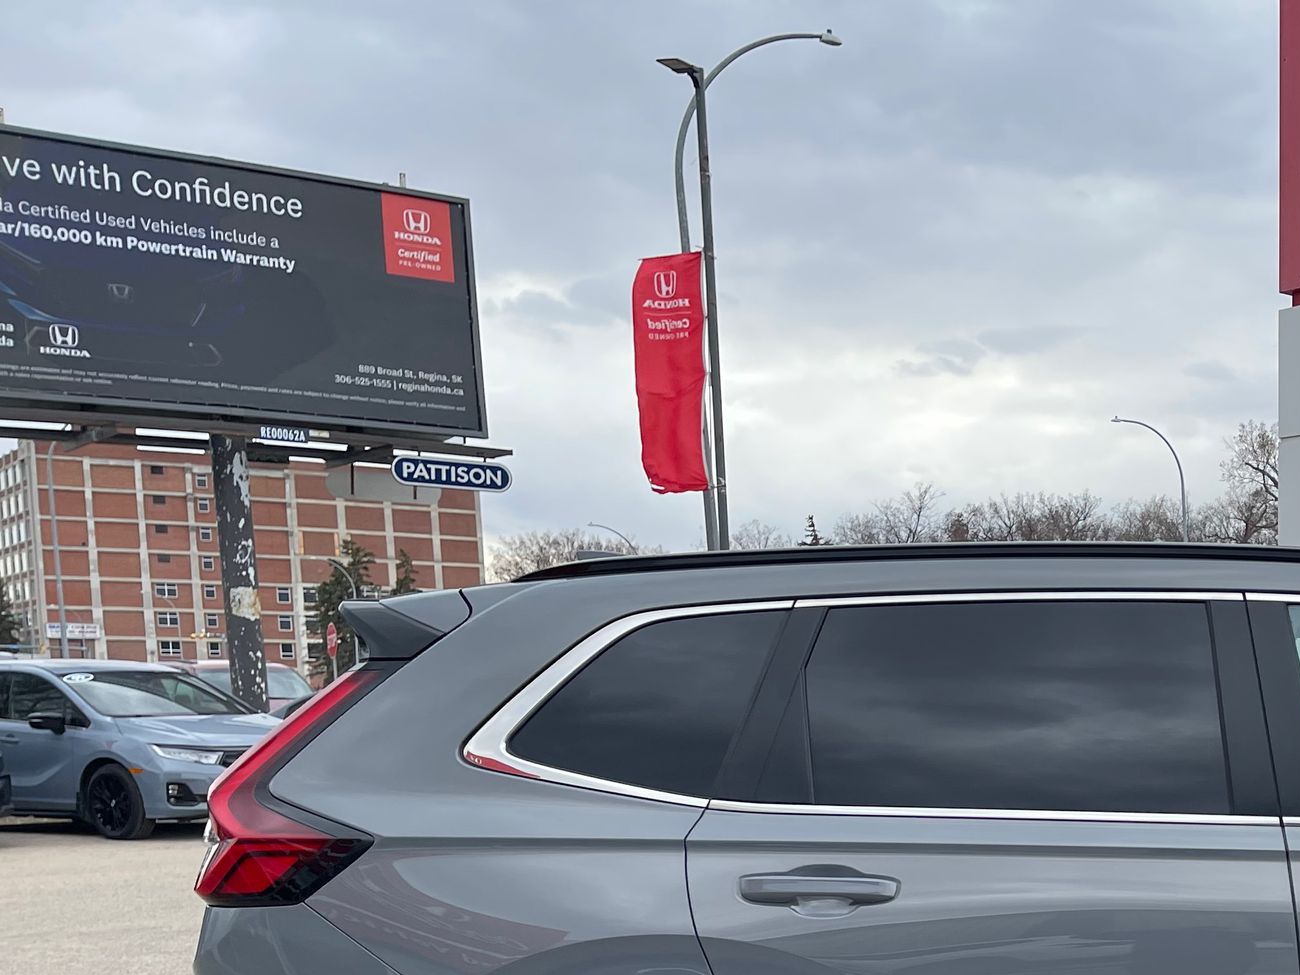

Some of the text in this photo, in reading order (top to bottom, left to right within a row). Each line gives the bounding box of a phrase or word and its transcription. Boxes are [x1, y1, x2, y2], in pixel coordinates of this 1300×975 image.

[51, 160, 121, 192] with
[131, 170, 303, 218] Confidence
[18, 200, 91, 224] Certified
[95, 210, 136, 230] Used
[140, 216, 207, 239] Vehicles
[210, 225, 267, 247] include
[270, 237, 280, 249] a
[393, 231, 442, 246] HONDA
[95, 230, 123, 249] km
[126, 236, 218, 261] Powertrain
[221, 248, 296, 274] Warranty
[398, 248, 440, 263] Certified
[40, 346, 92, 358] HONDA
[377, 365, 403, 378] Broad
[418, 371, 451, 384] Regina,
[451, 374, 464, 384] SK
[398, 381, 465, 397] reginahonda.ca
[401, 460, 502, 486] PATTISON
